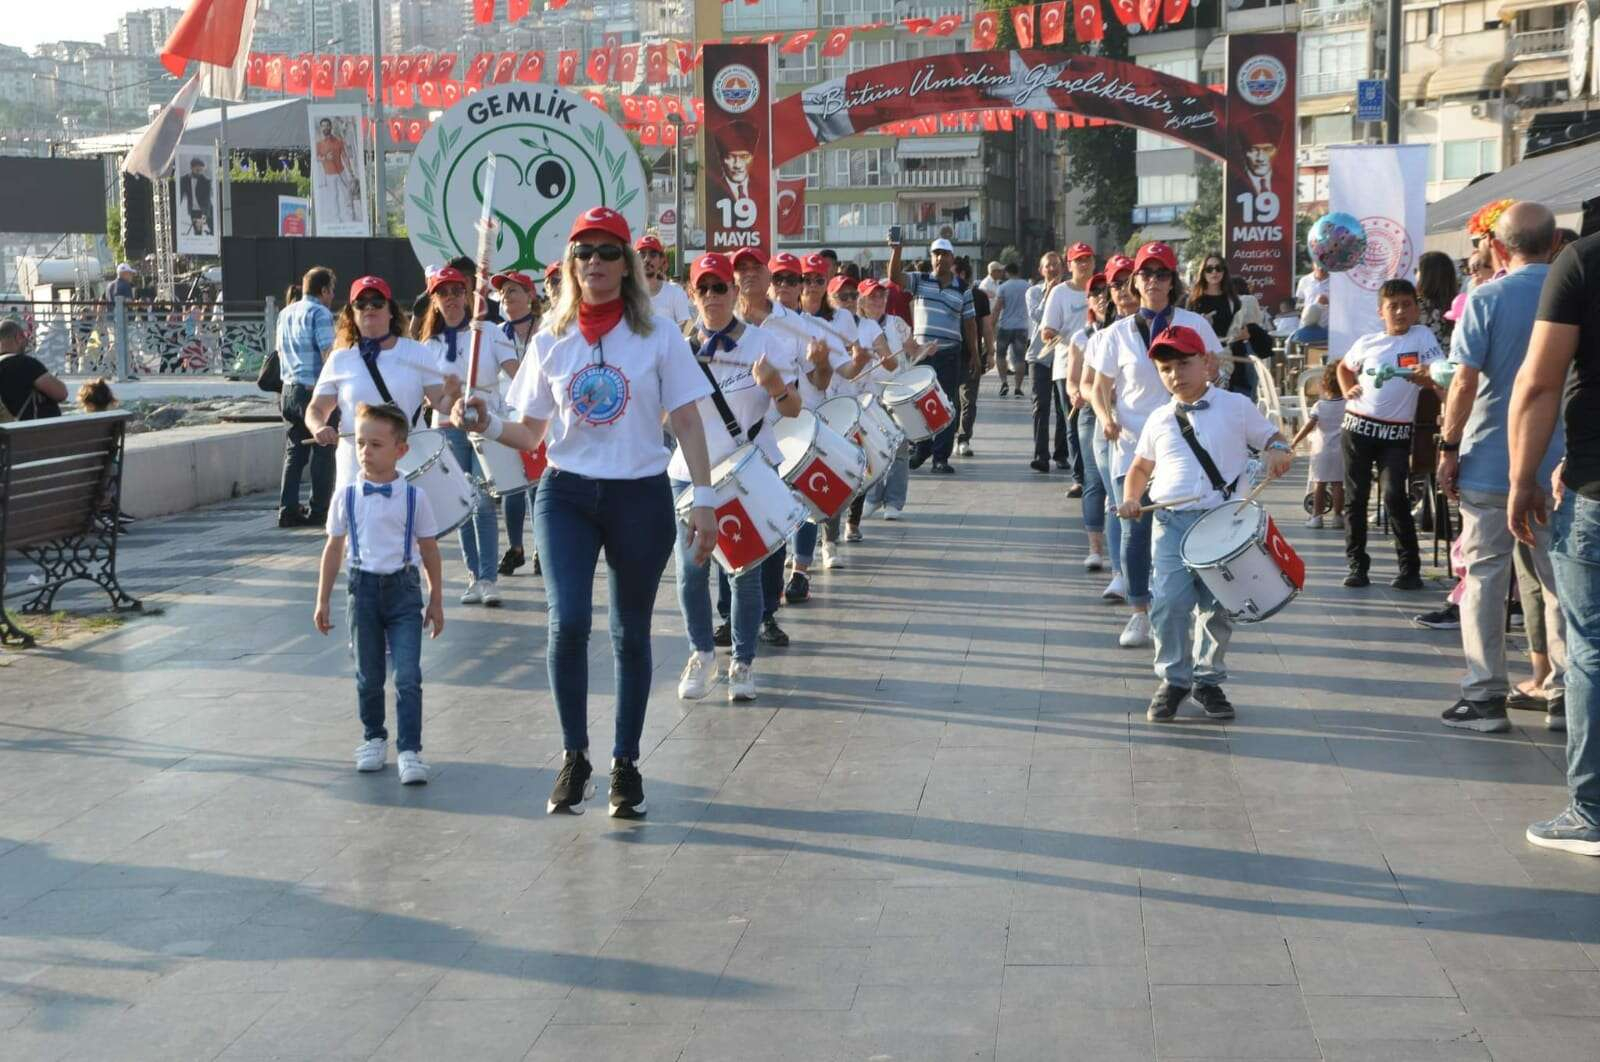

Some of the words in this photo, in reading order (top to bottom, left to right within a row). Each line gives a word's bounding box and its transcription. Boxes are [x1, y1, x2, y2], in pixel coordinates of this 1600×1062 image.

[909, 63, 1015, 97] Ümidim
[467, 89, 578, 126] GEMLİK
[716, 198, 758, 228] 19
[1236, 192, 1280, 223] 19
[713, 231, 761, 247] MAYIS
[1232, 227, 1283, 241] MAYIS
[1240, 264, 1273, 272] Anma
[1341, 413, 1410, 438] STREETWEAR
